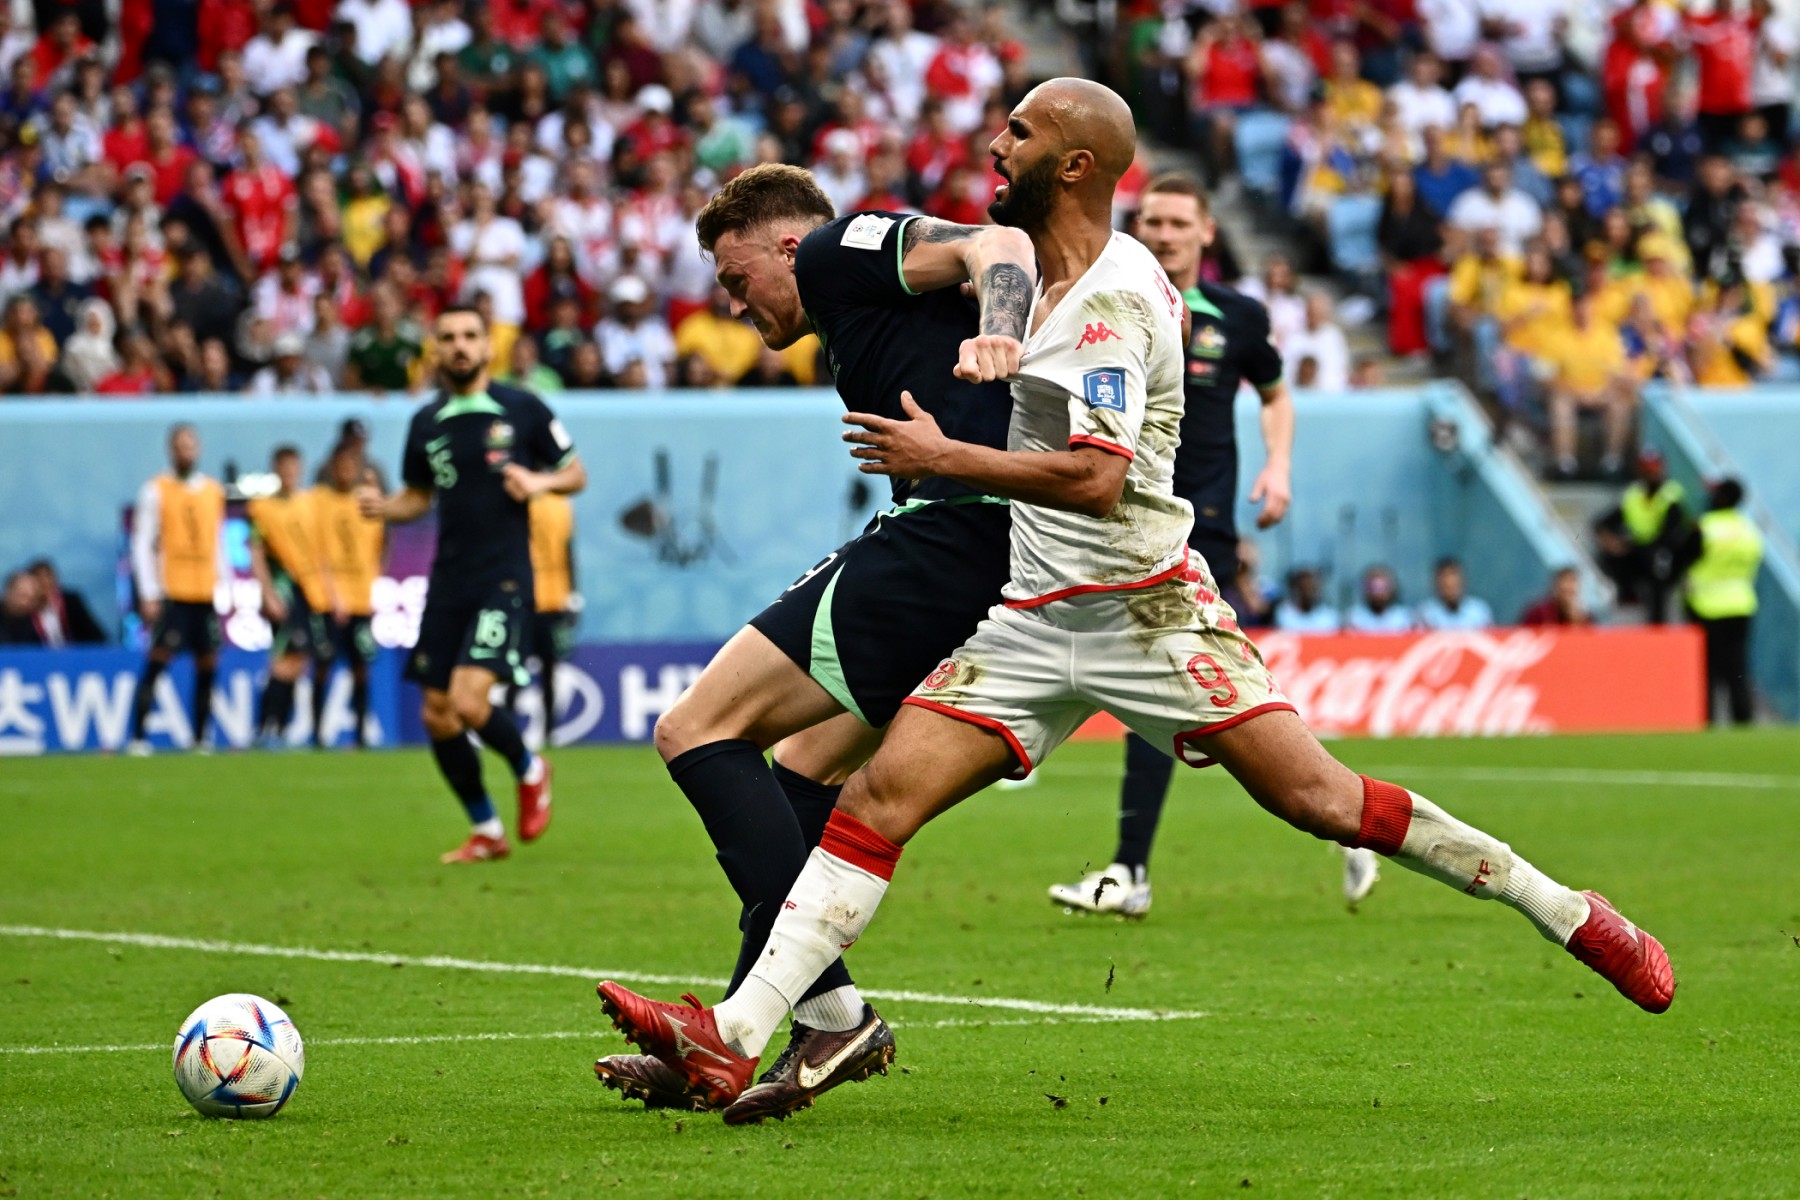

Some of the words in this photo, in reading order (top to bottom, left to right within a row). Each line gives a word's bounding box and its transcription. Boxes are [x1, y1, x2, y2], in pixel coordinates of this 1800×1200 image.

[474, 608, 508, 648] 16
[1187, 653, 1239, 708] 9
[1464, 858, 1492, 896] FTF
